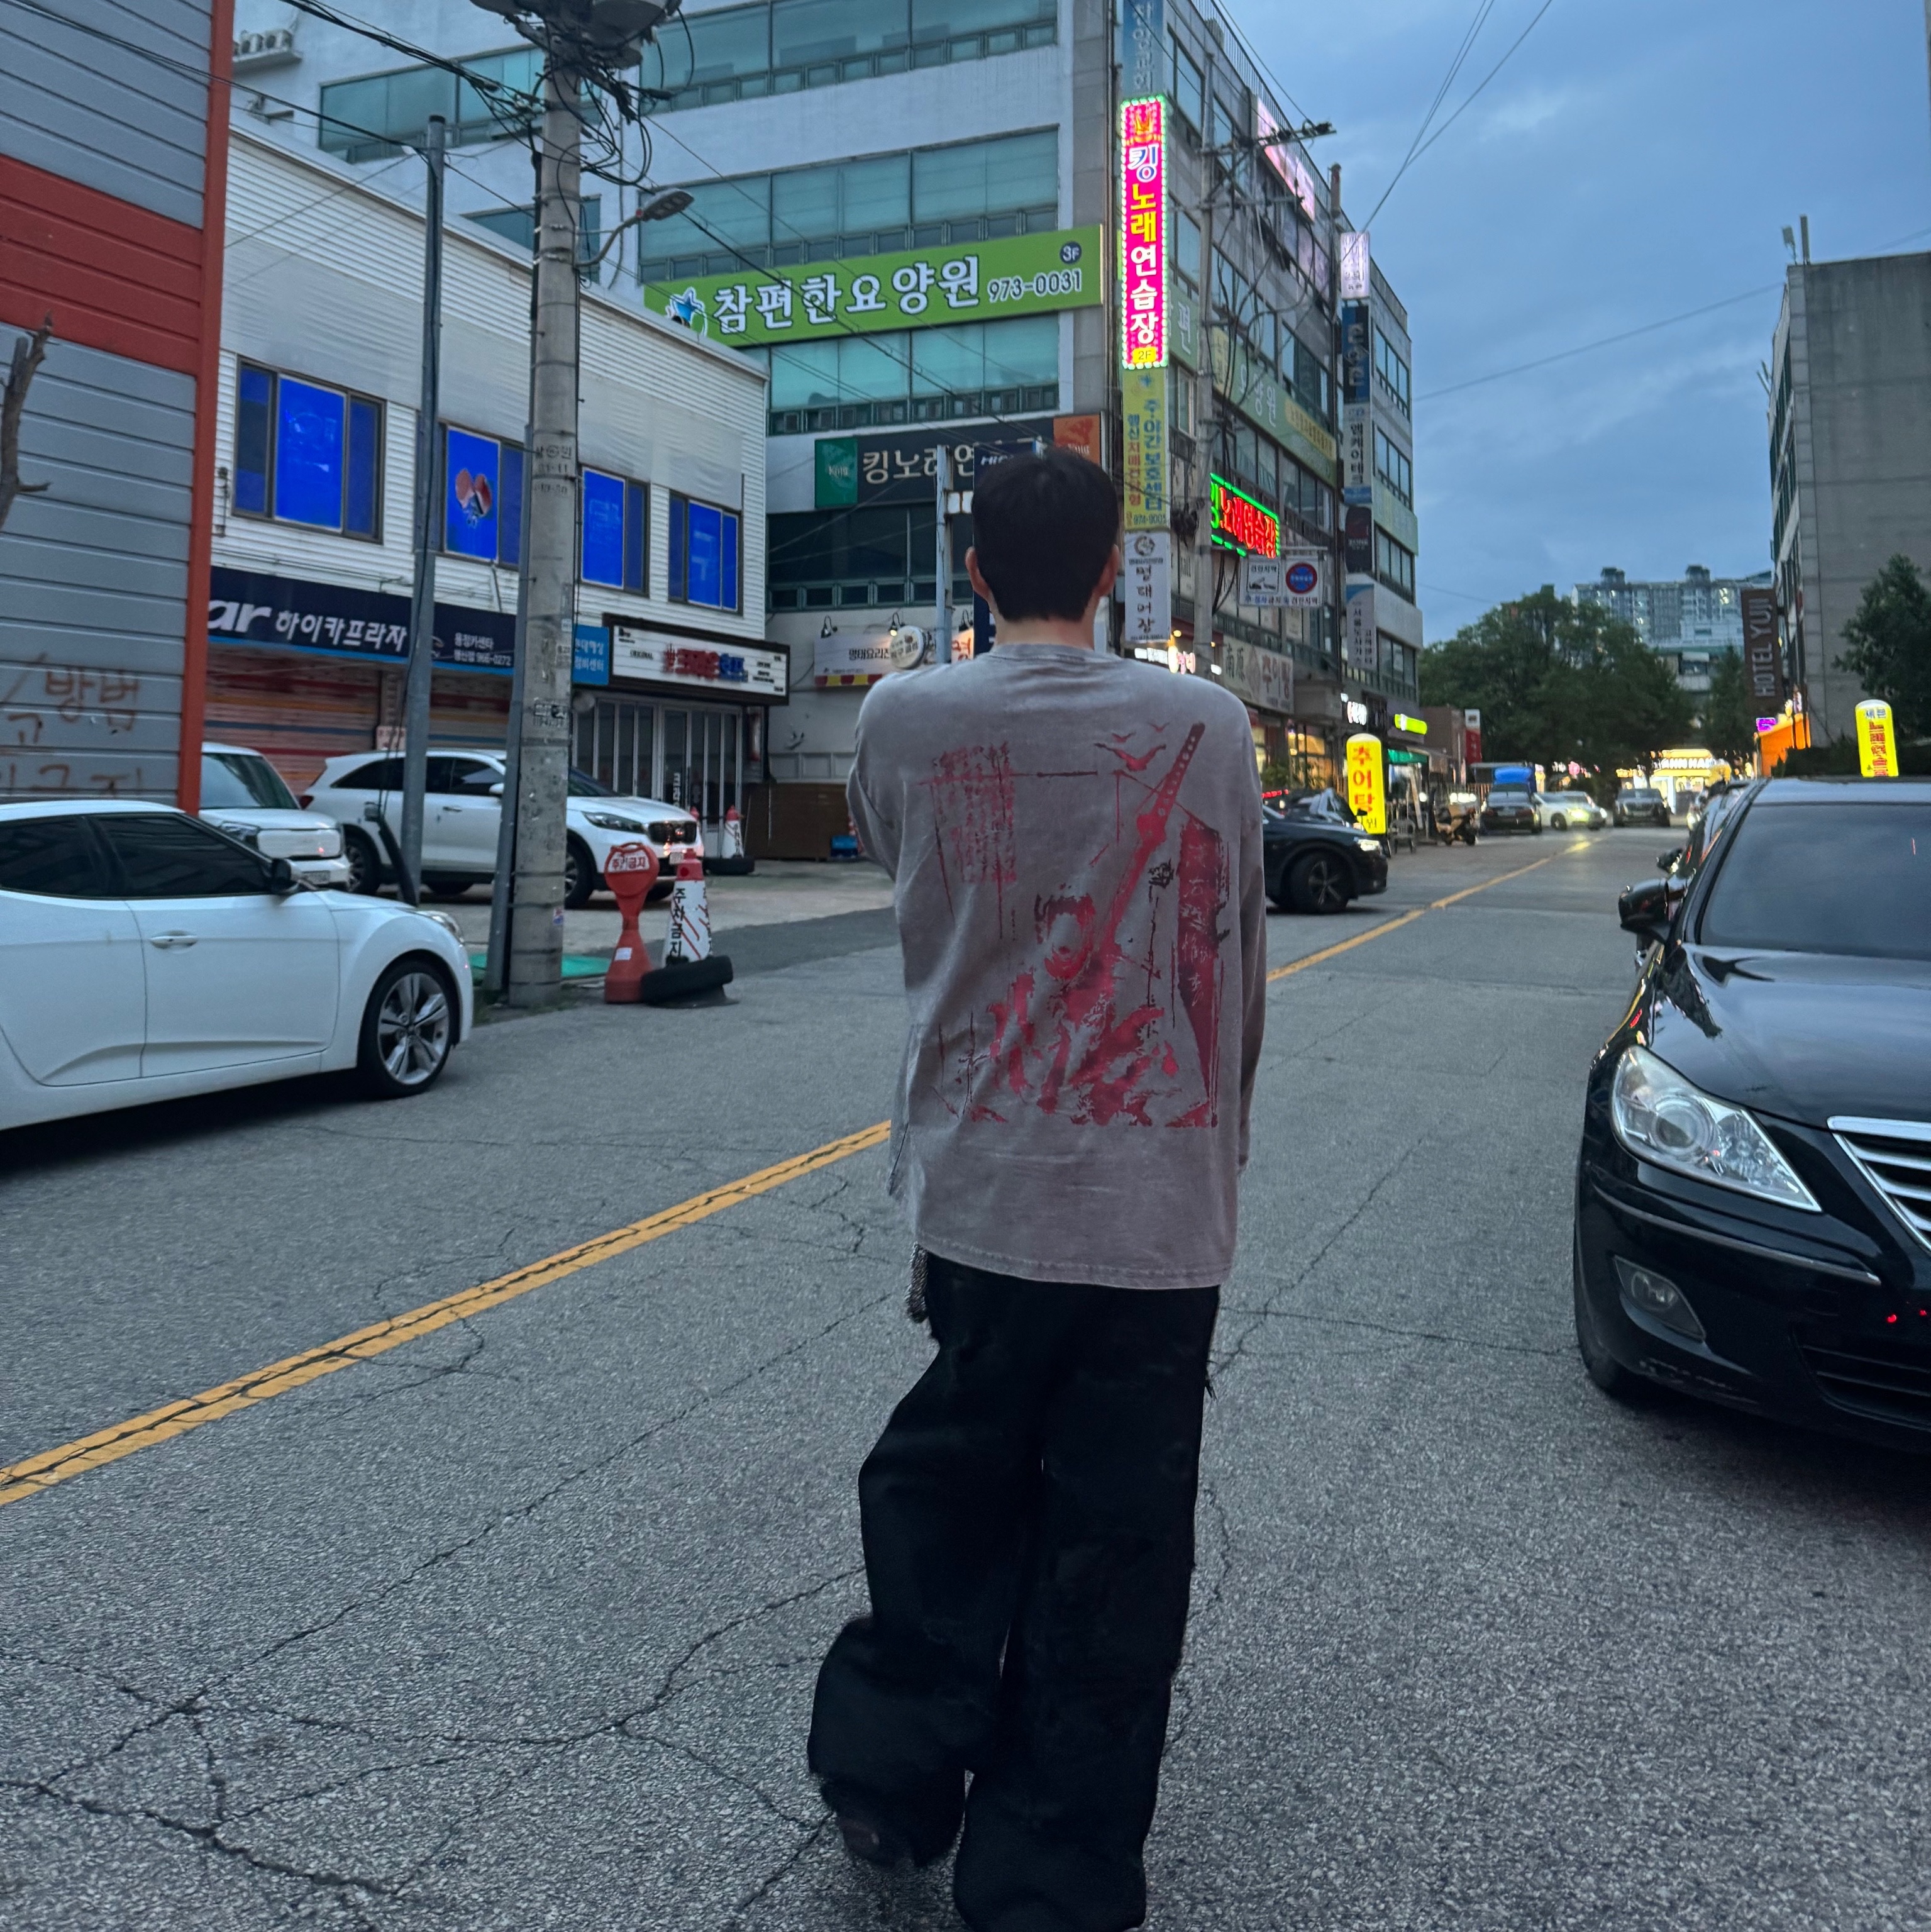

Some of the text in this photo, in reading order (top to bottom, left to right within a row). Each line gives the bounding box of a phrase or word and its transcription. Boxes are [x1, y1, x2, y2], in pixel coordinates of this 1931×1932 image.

[1062, 244, 1080, 261] 3F
[1128, 145, 1159, 345] 킹노래연습장
[713, 254, 1083, 335] 참편한요양원 973-0031
[1138, 350, 1152, 361] 2F
[275, 610, 407, 652] 하이카프라자
[1752, 642, 1776, 697] HOTEL
